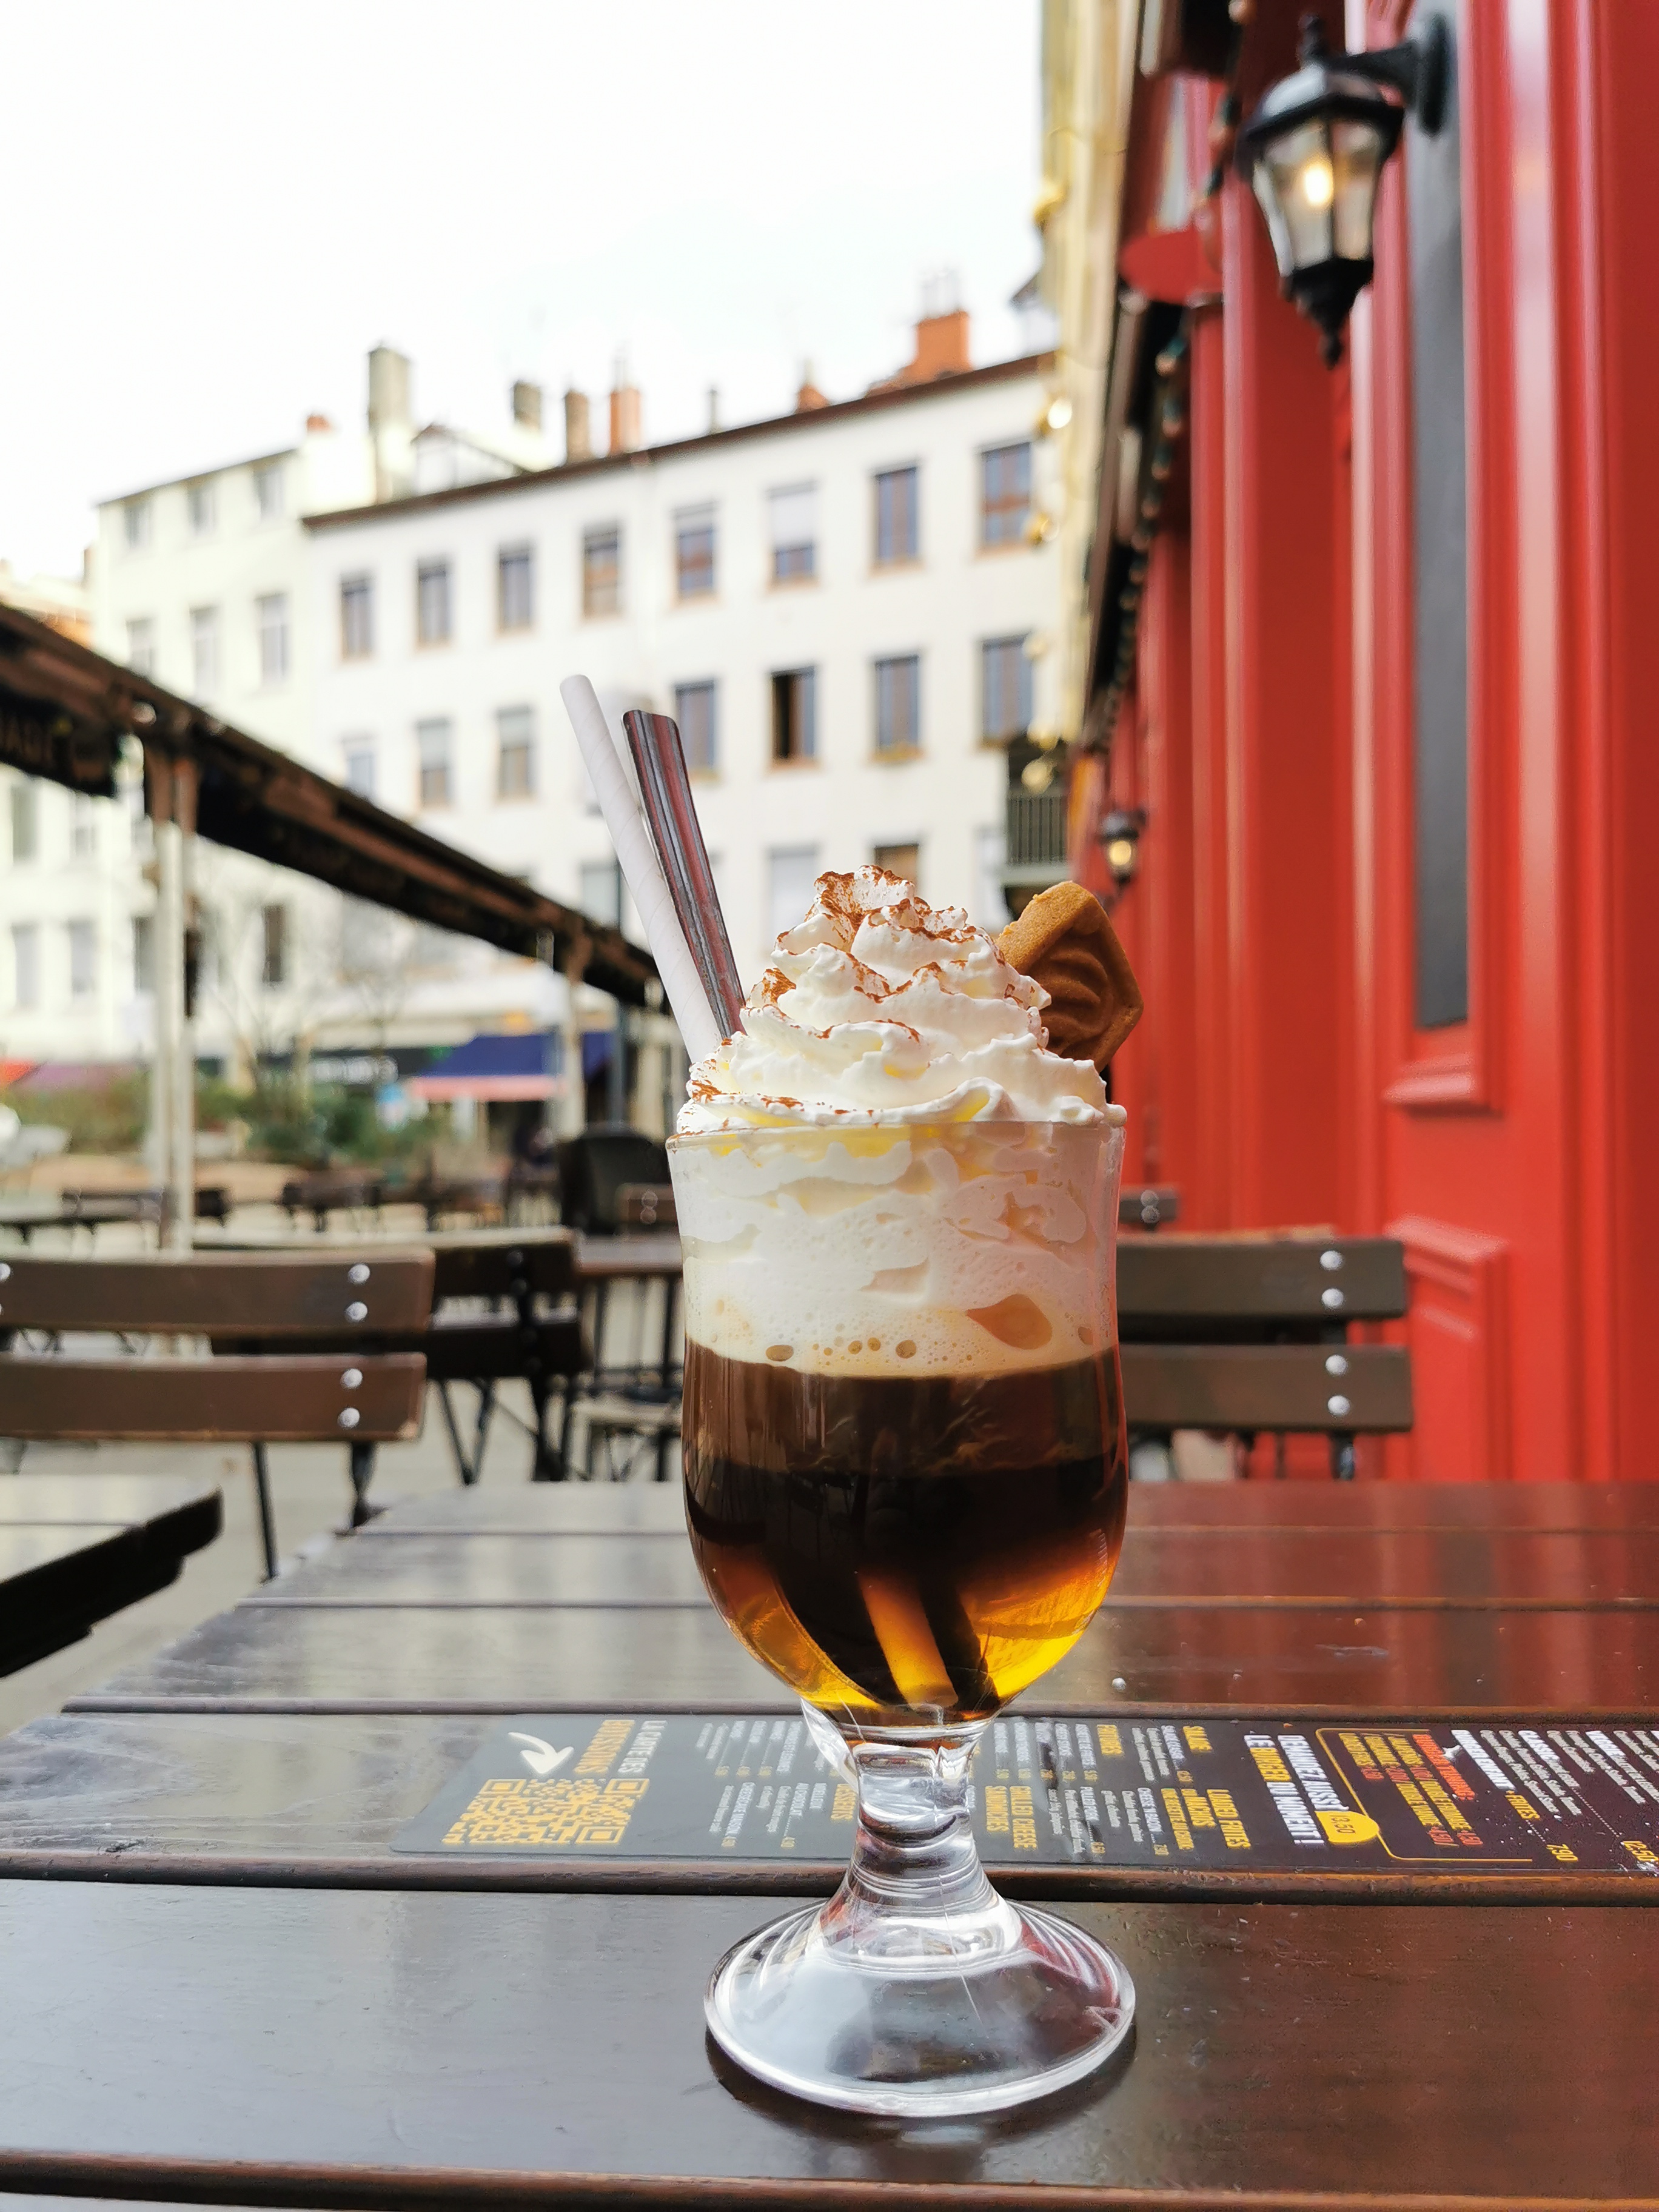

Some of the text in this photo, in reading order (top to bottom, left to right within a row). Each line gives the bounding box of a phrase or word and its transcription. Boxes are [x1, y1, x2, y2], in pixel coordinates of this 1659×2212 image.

[570, 1719, 636, 1774] BOISSONS
[616, 1720, 668, 1772] LA CARTE DES
[1096, 1724, 1123, 1754] FRITURES
[1182, 1726, 1213, 1750] SALADE
[1242, 1735, 1275, 1746] LE
[1410, 1734, 1452, 1765] BURGER
[1581, 1730, 1627, 1755] VEGGIE
[1248, 1747, 1293, 1781] BURGER
[1276, 1735, 1346, 1809] DEMANDEZ AUSSI
[1136, 1788, 1155, 1807] CHEESE
[1265, 1782, 1300, 1795] DU
[1394, 1783, 1427, 1804] DOUBLE
[1418, 1781, 1452, 1801] DOUBLE
[1449, 1729, 1491, 1757] BURGER
[1473, 1758, 1517, 1788] ENFANT
[1504, 1795, 1543, 1818] FRITES
[1543, 1844, 1580, 1860] 7,90
[1515, 1730, 1562, 1759] CLASSIC
[1619, 1841, 1659, 1860] 12,50
[985, 1786, 1008, 1832] SANDWICHES
[1009, 1786, 1036, 1848] GRILLED CHEESE
[1143, 1813, 1162, 1832] BACON
[1164, 1799, 1185, 1821] RECETTE
[1183, 1797, 1216, 1826] NACHOS
[1205, 1789, 1252, 1848] LOADED FRITES
[1272, 1796, 1322, 1837] MOMENT
[1409, 1805, 1442, 1825] VIANDE
[1433, 1803, 1473, 1829] FROMAGE
[1327, 1815, 1358, 1834] 13,50
